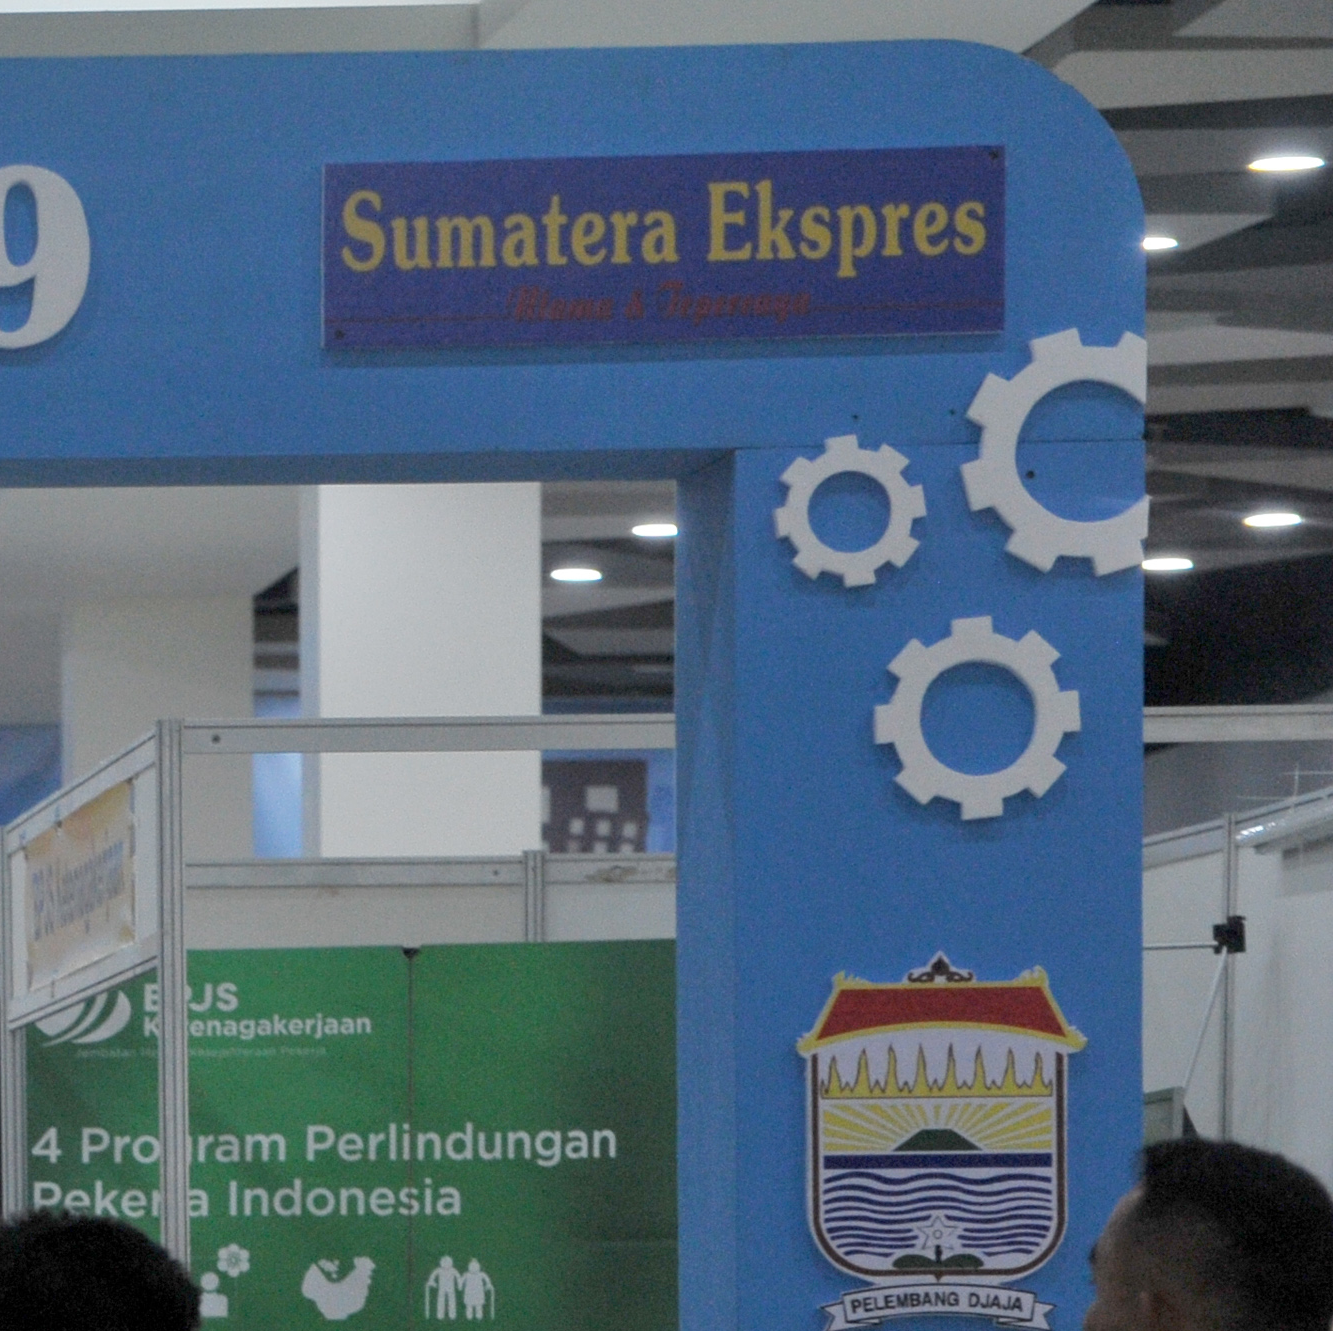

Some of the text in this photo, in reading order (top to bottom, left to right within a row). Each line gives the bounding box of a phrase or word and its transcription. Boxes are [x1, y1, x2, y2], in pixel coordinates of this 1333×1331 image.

[341, 179, 988, 278] Sumatera Ekspres
[144, 982, 239, 1012] BJS
[144, 1013, 372, 1040] Kenagakerjaan
[31, 1122, 618, 1167] 4 Proram Perlindungan
[33, 1177, 462, 1218] Pekera Indonesia
[850, 1291, 1024, 1315] PELEMBANG DJAJA
